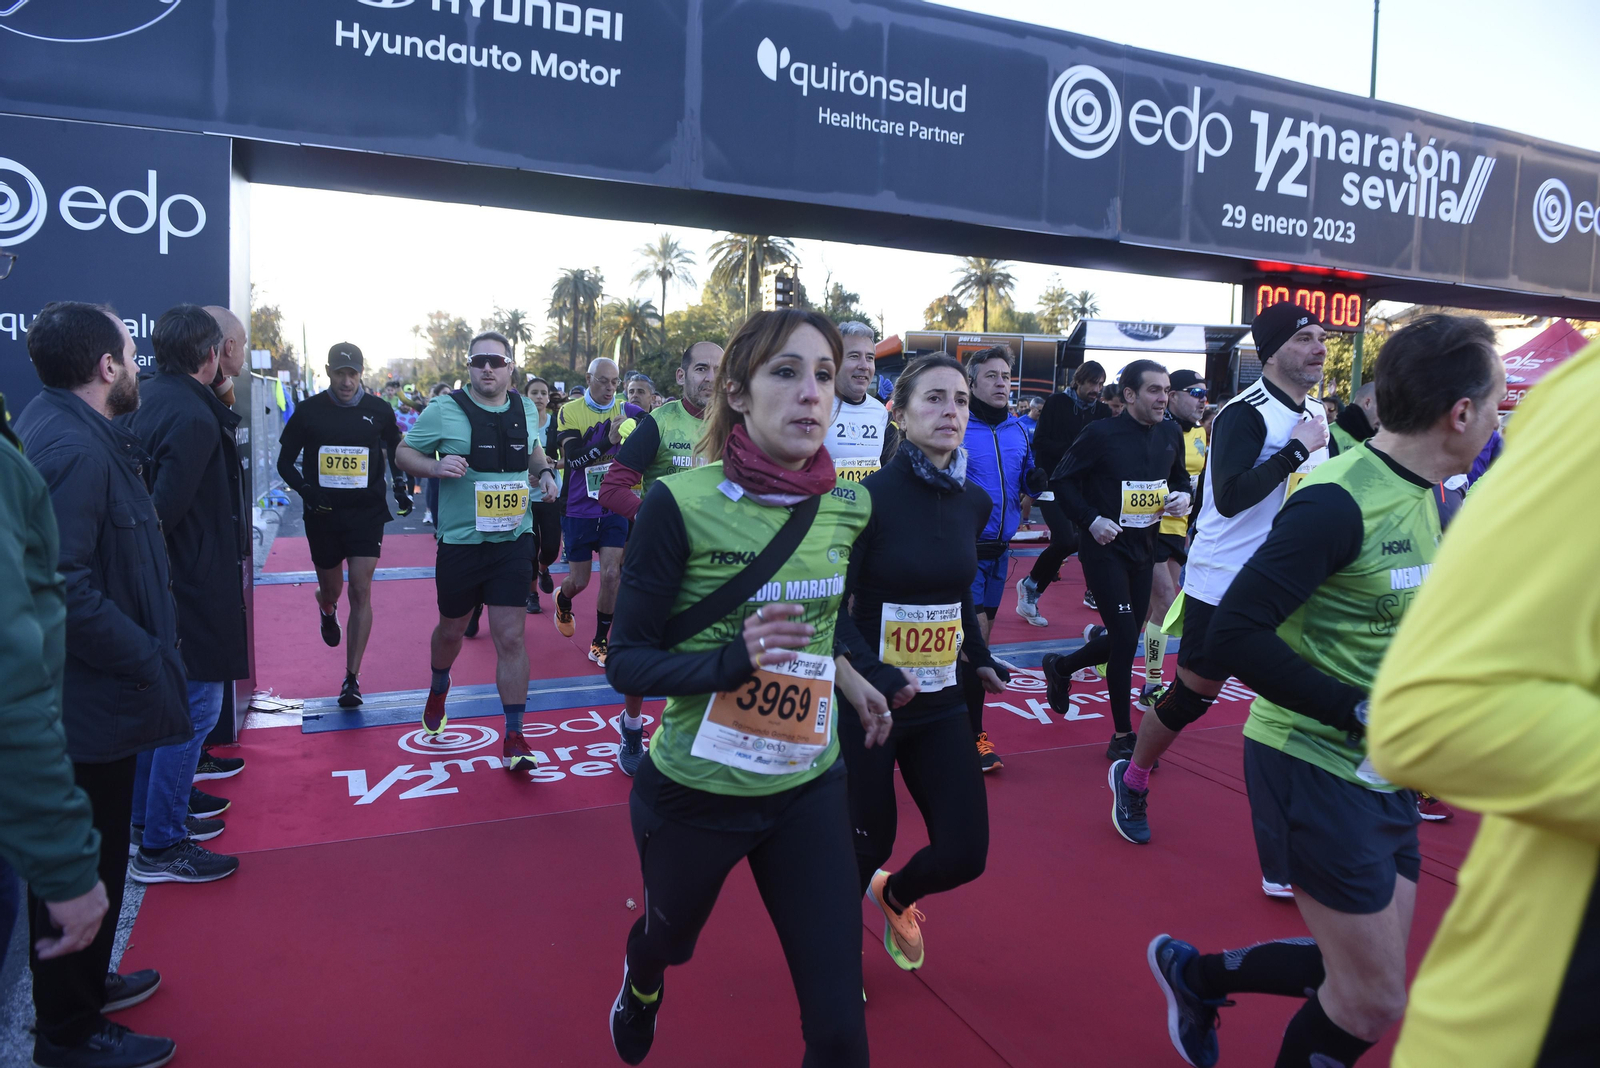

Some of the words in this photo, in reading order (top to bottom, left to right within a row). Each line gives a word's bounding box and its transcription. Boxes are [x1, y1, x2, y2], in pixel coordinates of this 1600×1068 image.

[335, 20, 522, 73] Hyundauto
[530, 49, 622, 87] Motor
[789, 61, 967, 113] quirónsalud
[818, 106, 905, 137] Healthcare
[909, 120, 965, 146] Partner
[1128, 86, 1233, 173] edp
[1300, 120, 1461, 184] maratón
[1341, 172, 1460, 223] sevilla
[59, 169, 206, 255] edp
[1221, 203, 1246, 228] 29
[1252, 212, 1308, 237] enero
[1312, 217, 1356, 244] 2023
[668, 442, 692, 450] HOKA
[326, 456, 358, 470] 9765
[838, 470, 875, 483] 1031
[484, 493, 518, 509] 9159
[831, 487, 856, 501] 2023
[1130, 493, 1161, 507] 8834
[710, 552, 757, 565] HOKA
[1382, 539, 1412, 555] HOKA
[785, 572, 845, 601] MARATÓN
[907, 610, 924, 620] edp
[891, 626, 956, 653] 10287
[736, 676, 812, 723] 3969
[766, 741, 786, 754] edp
